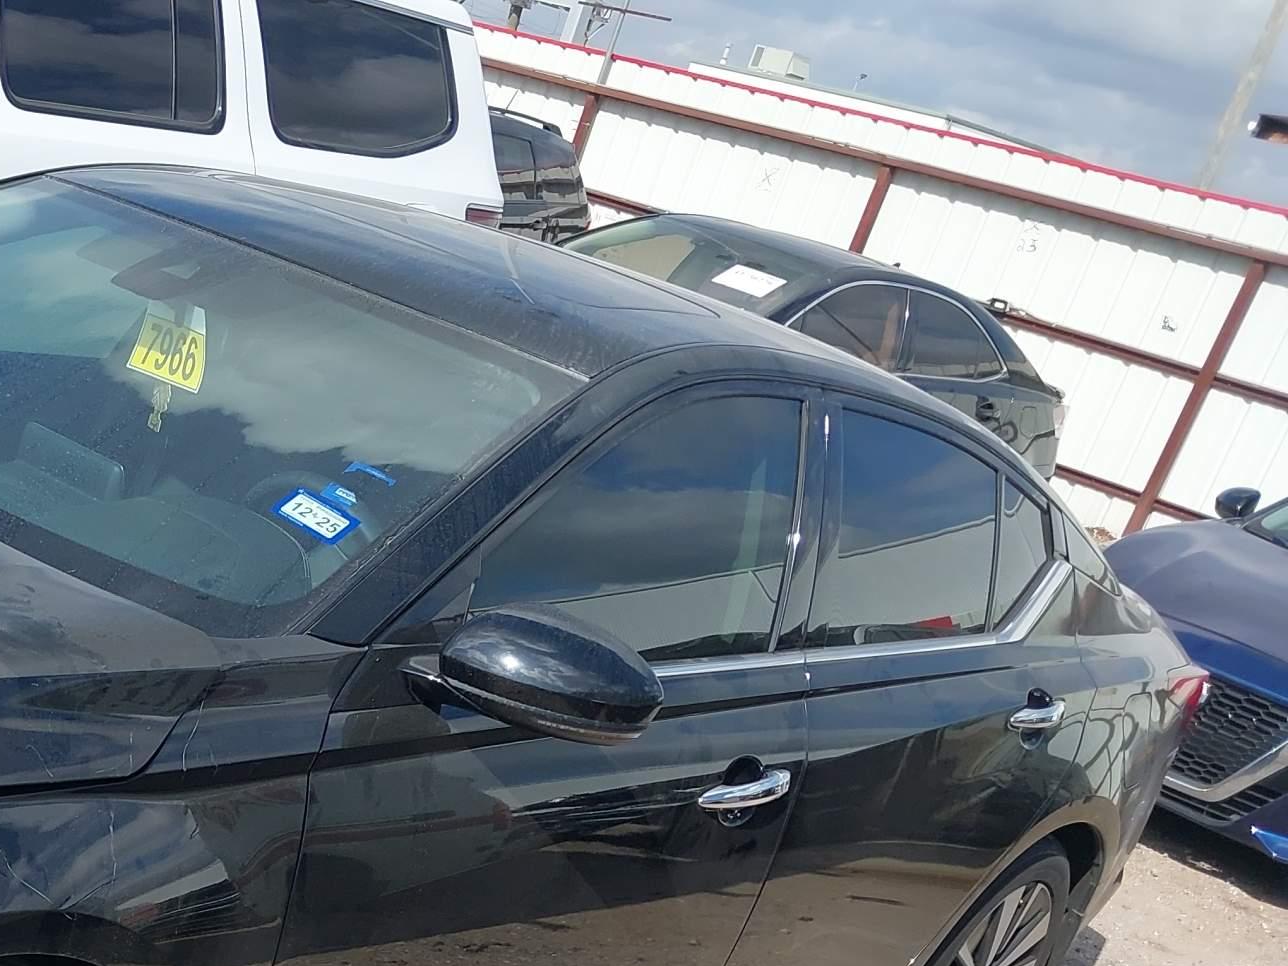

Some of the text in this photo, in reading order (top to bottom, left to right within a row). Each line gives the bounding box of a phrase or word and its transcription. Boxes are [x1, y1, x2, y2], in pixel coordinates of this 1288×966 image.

[139, 322, 199, 381] 7966
[291, 501, 313, 519] 12
[315, 516, 342, 534] 25
